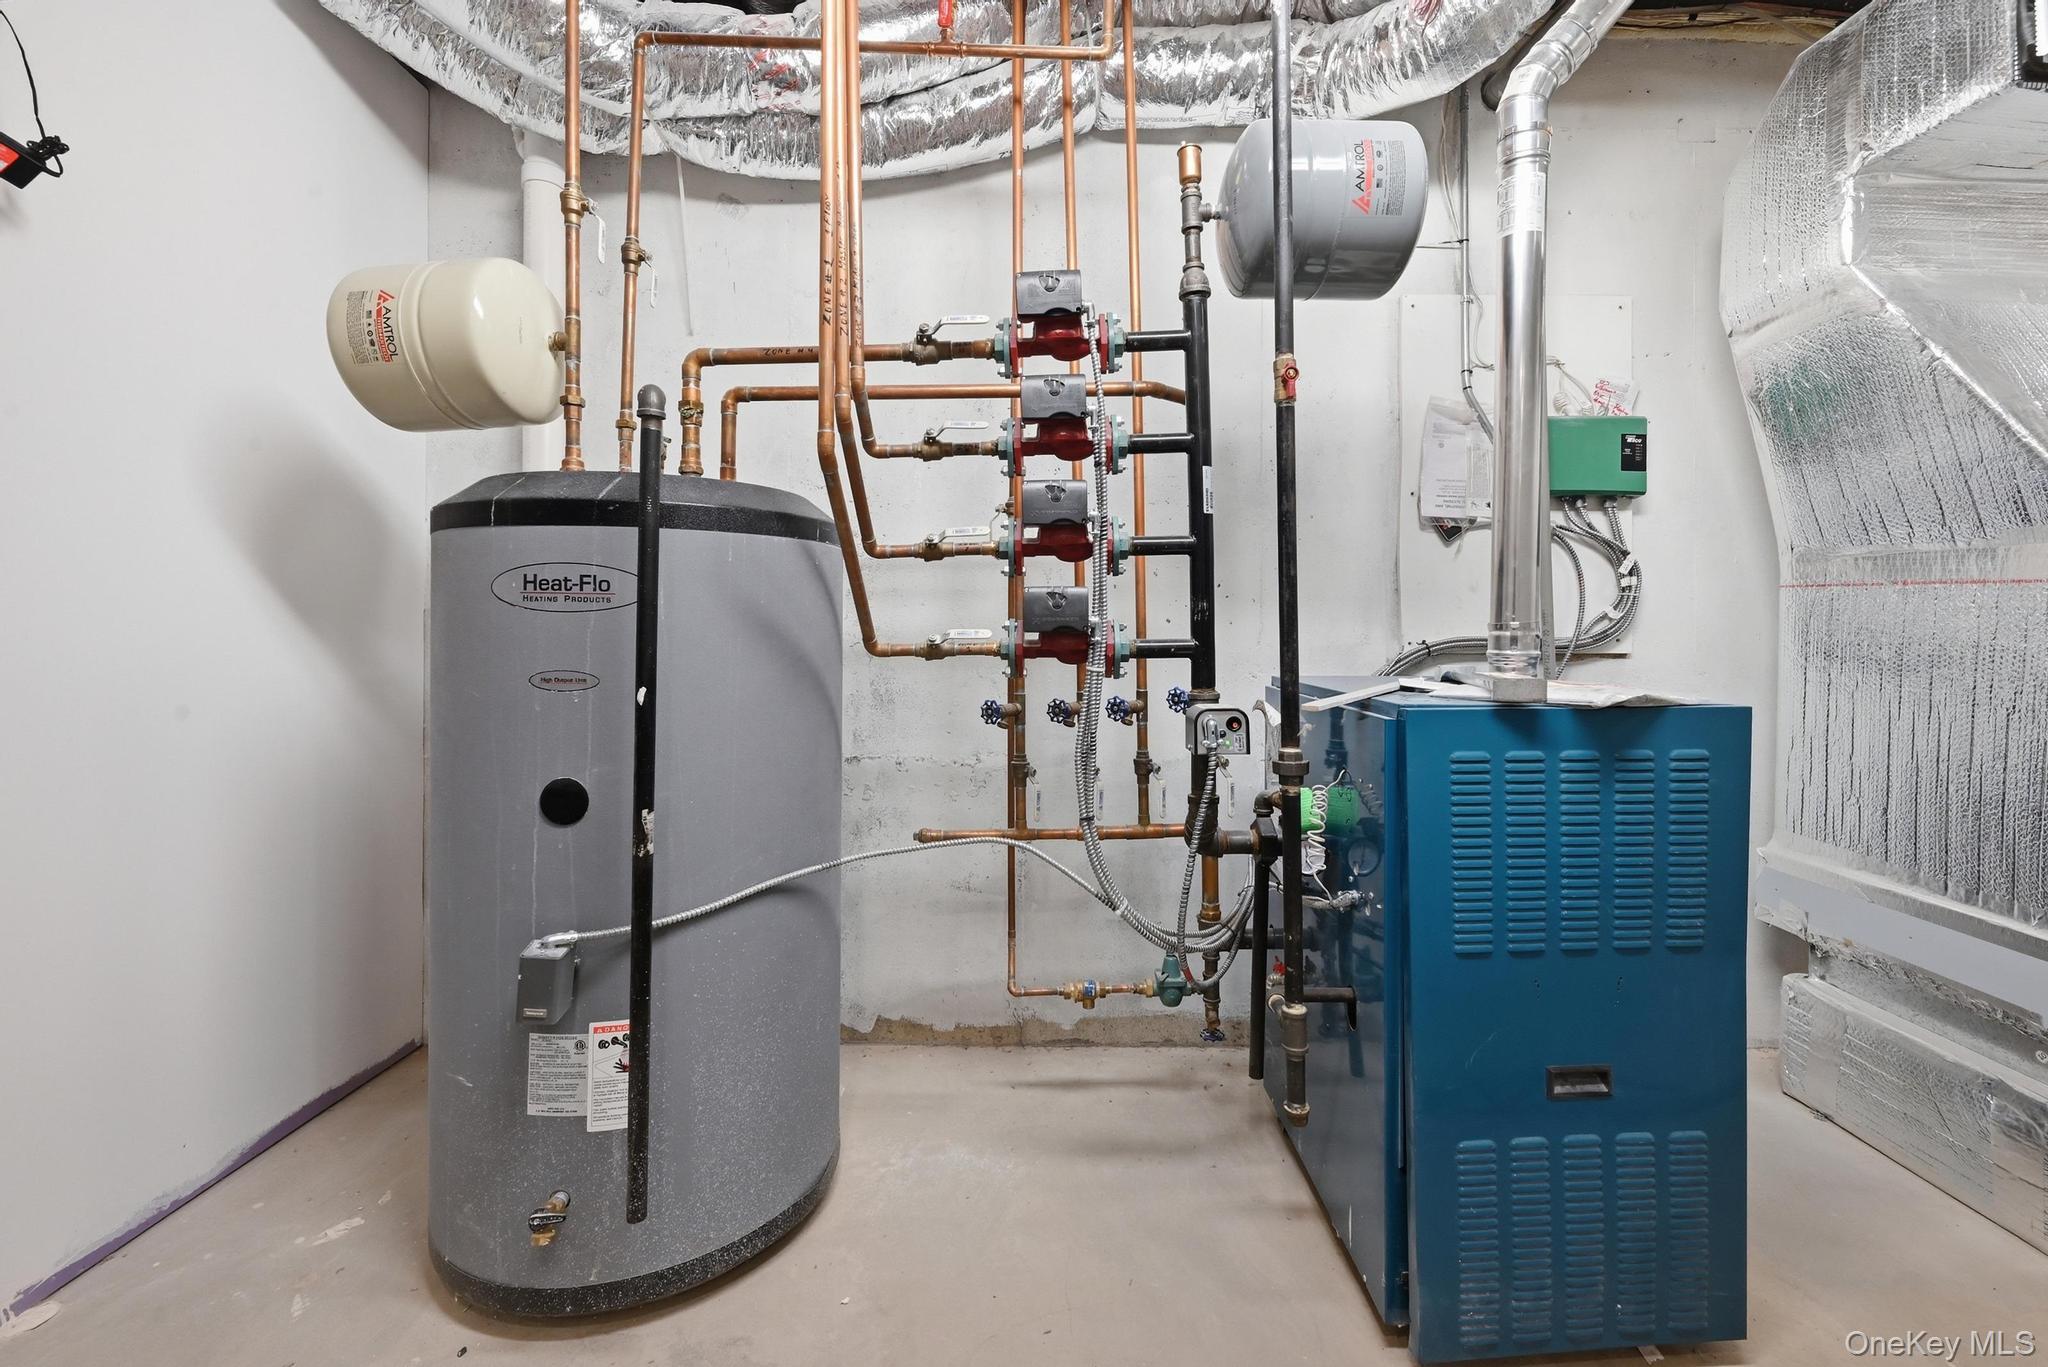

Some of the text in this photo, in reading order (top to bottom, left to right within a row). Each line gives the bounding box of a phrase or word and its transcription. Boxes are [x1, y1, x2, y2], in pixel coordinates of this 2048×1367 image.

[1354, 140, 1365, 192] AMTROL
[822, 288, 832, 326] ZONE
[839, 303, 849, 336] ZONE
[382, 305, 398, 361] AMTROL
[763, 348, 791, 356] ZONE
[522, 573, 612, 592] Heat-Flo
[522, 595, 612, 603] HEATING PRODUCTS
[604, 1024, 629, 1032] DANG
